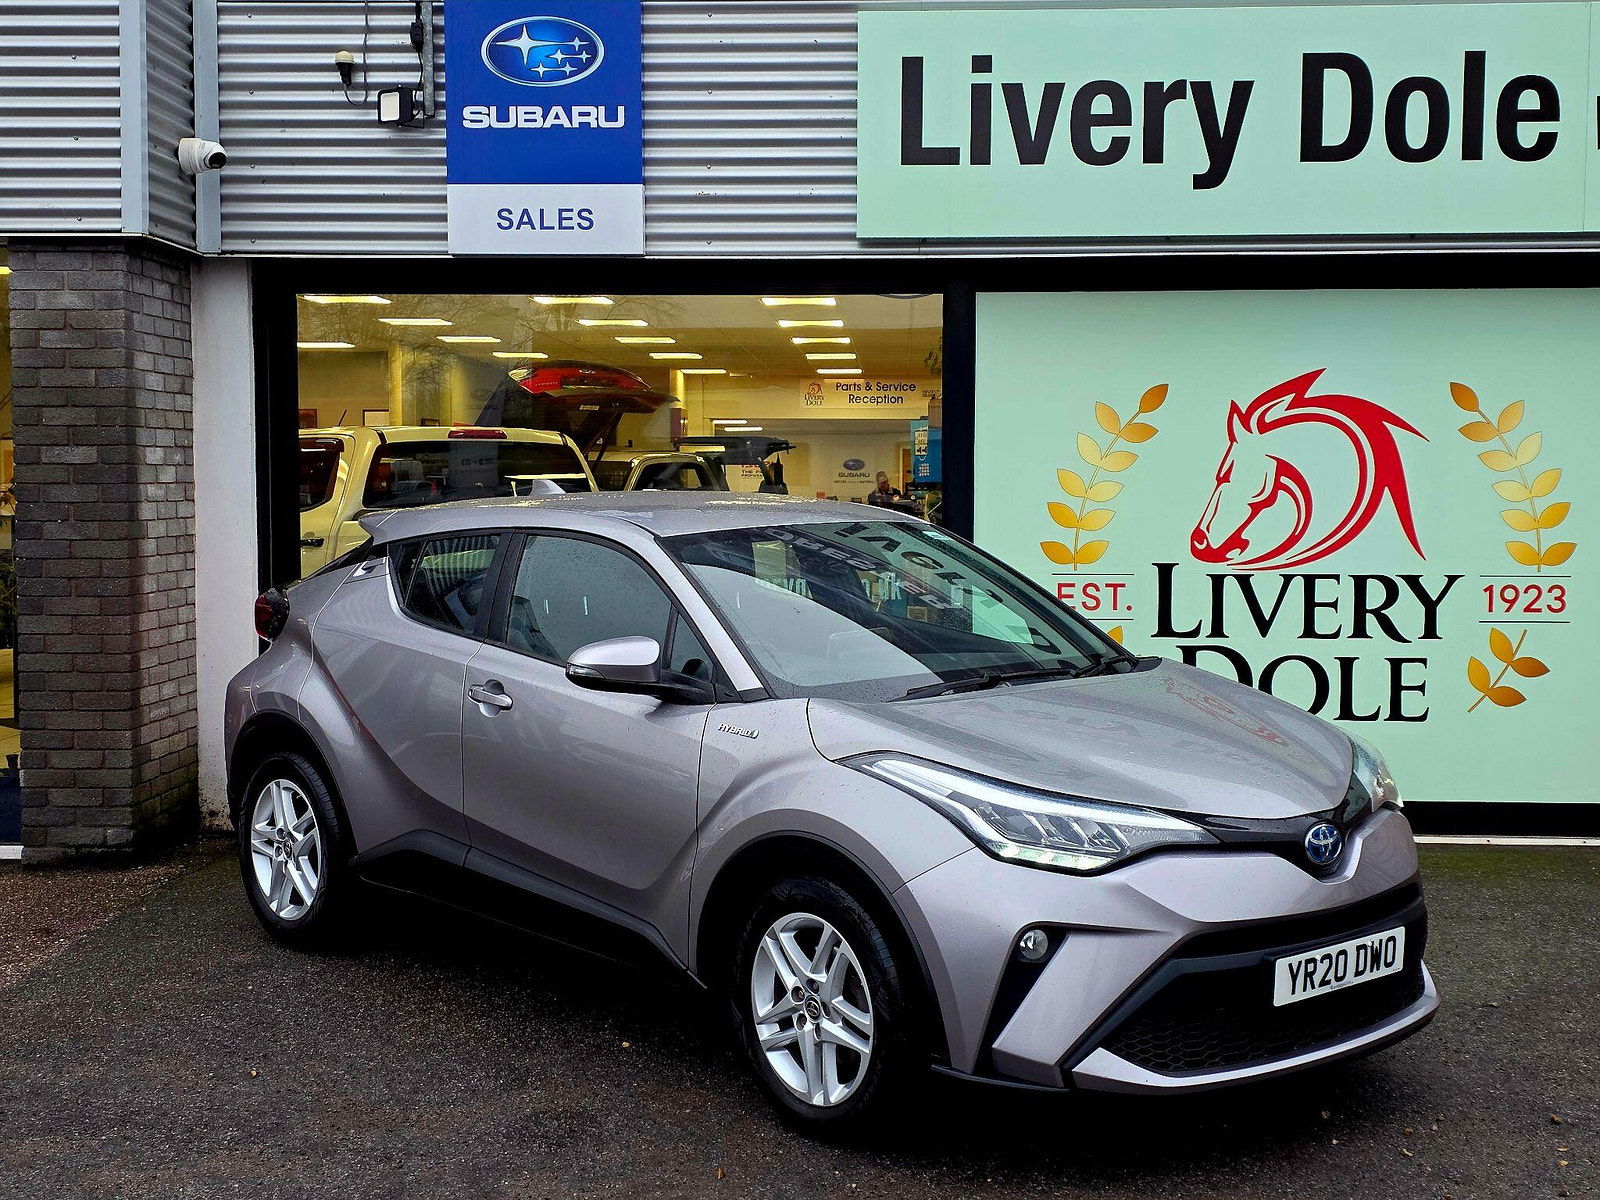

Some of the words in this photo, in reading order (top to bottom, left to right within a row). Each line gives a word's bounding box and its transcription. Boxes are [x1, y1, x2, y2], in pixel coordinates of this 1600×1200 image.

[461, 104, 626, 130] SUBARU
[899, 53, 1255, 191] Livery
[1299, 49, 1561, 164] Dole
[496, 207, 595, 231] SALES
[835, 382, 861, 392] Parts
[865, 382, 873, 392] &
[875, 381, 916, 392] Service
[848, 393, 904, 406] Reception
[1056, 582, 1134, 612] EST.
[1151, 562, 1465, 643] LIVERY
[1483, 584, 1568, 614] 1923
[1288, 948, 1349, 996] YR20
[1354, 935, 1397, 977] DWO
